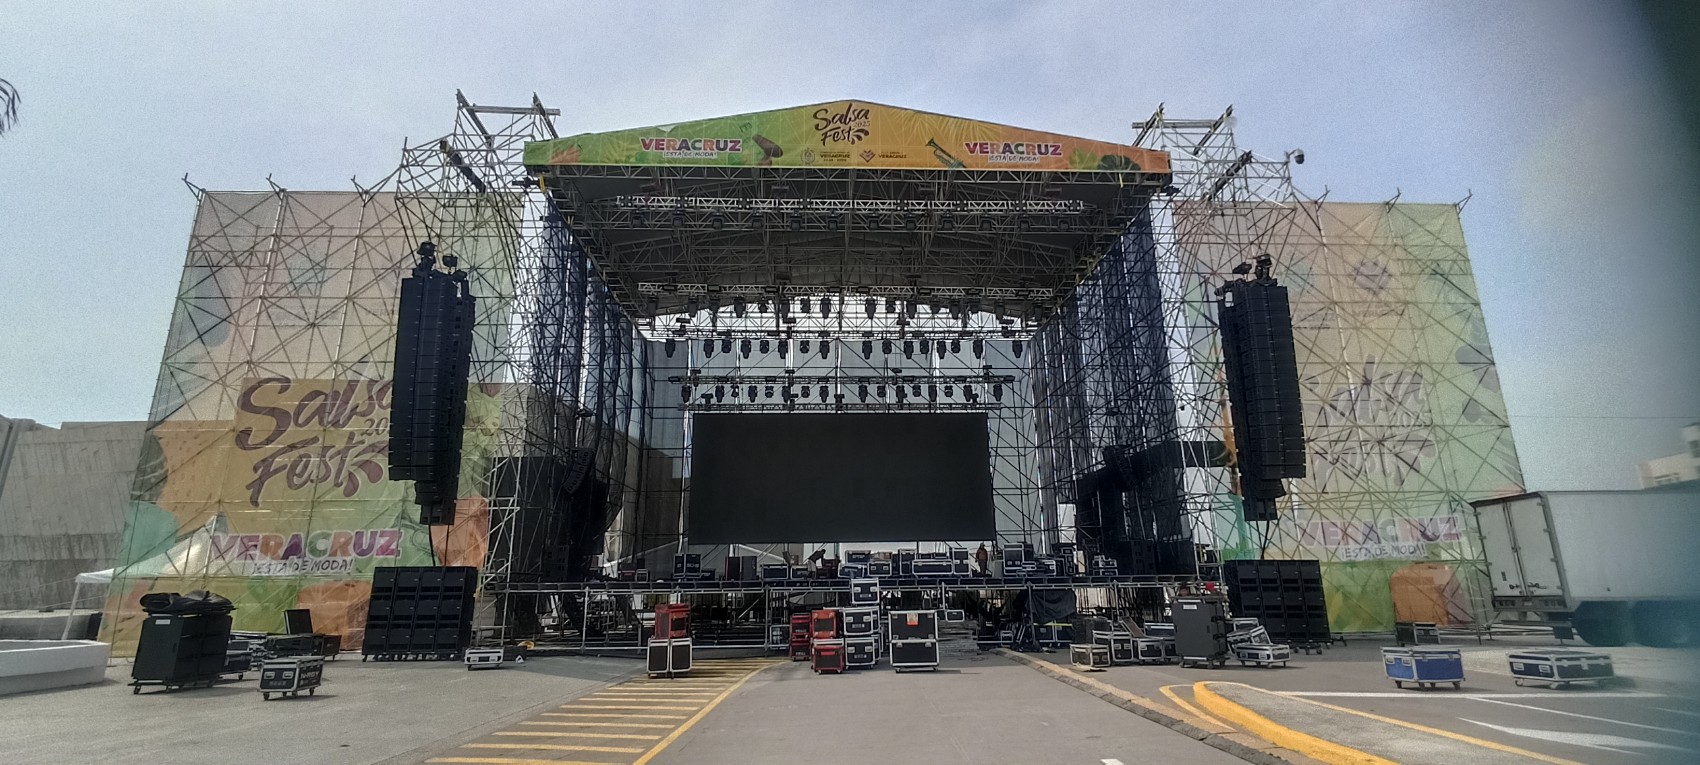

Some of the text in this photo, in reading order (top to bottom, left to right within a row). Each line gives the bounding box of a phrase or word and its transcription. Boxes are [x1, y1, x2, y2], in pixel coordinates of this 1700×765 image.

[812, 102, 871, 132] Salsa
[640, 138, 742, 152] VERACRUZ
[820, 126, 854, 147] Fest
[964, 142, 1063, 156] VERACRUZ
[360, 417, 389, 437] 20
[245, 431, 367, 507] Fest
[1300, 516, 1463, 546] VERACRUZ
[212, 530, 403, 561] VERACRUZ
[293, 559, 309, 571] DE
[310, 558, 355, 573] MODA!
